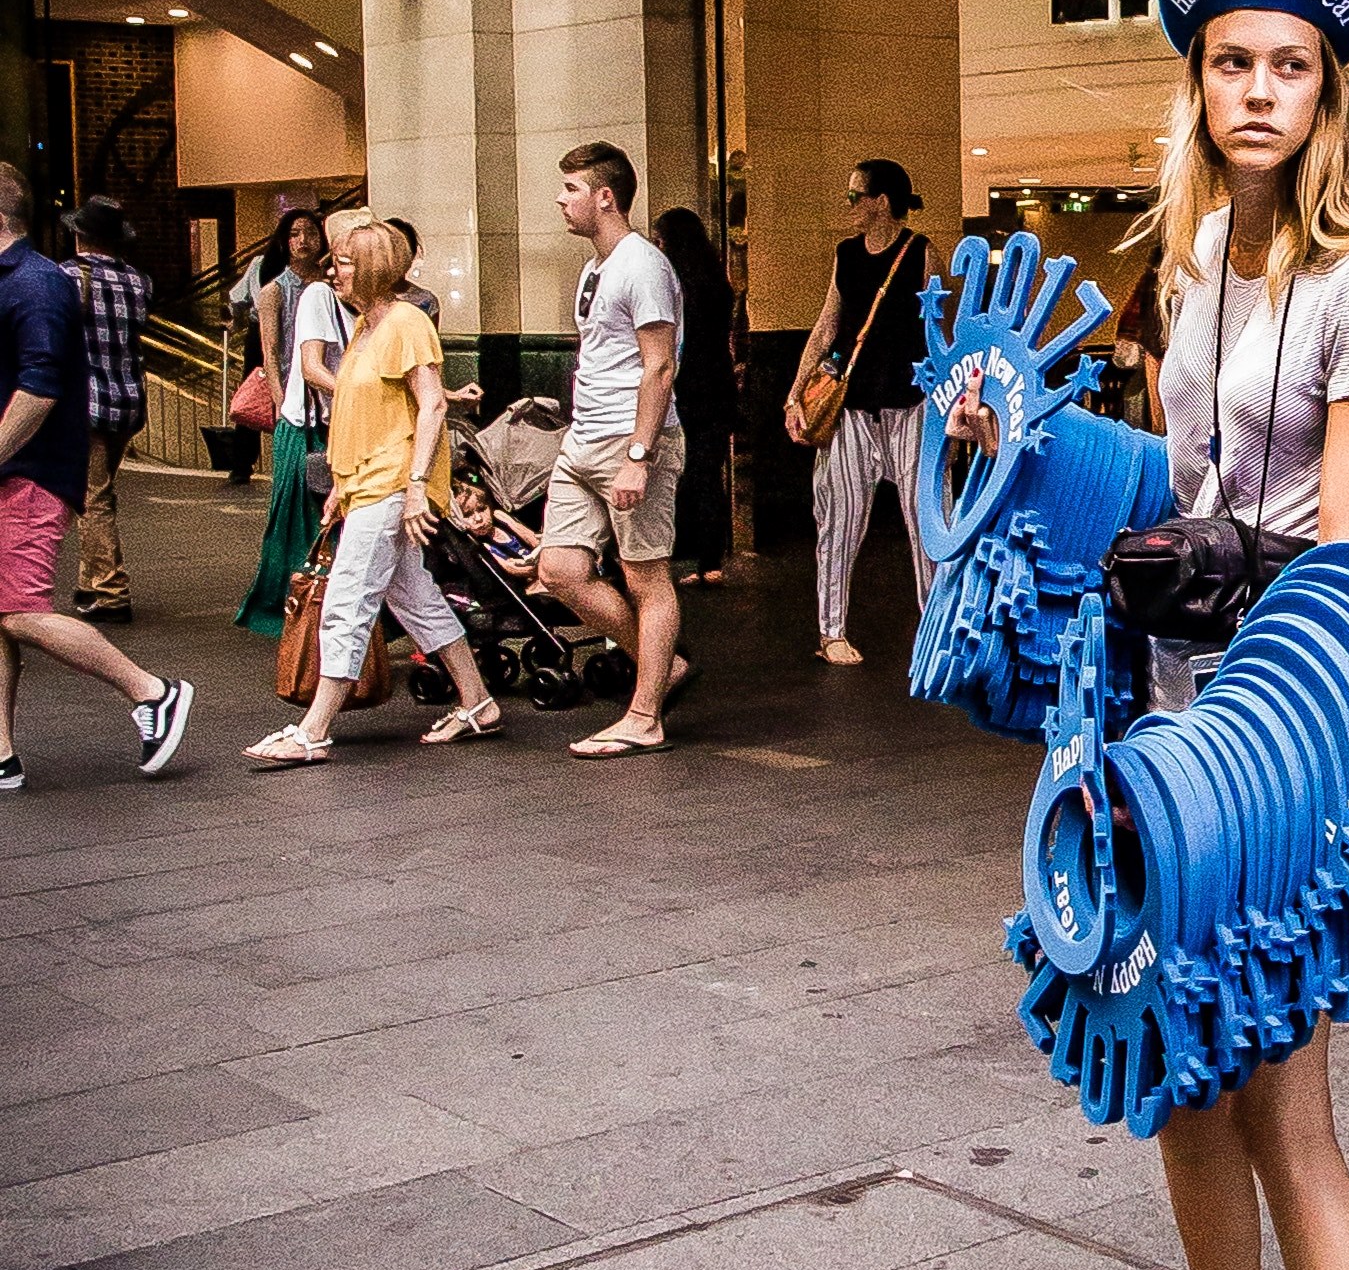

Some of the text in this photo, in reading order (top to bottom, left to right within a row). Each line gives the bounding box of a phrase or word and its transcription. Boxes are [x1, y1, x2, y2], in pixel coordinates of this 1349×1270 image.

[950, 231, 1113, 367] 2017
[931, 350, 984, 417] Happy
[985, 345, 1017, 387] New
